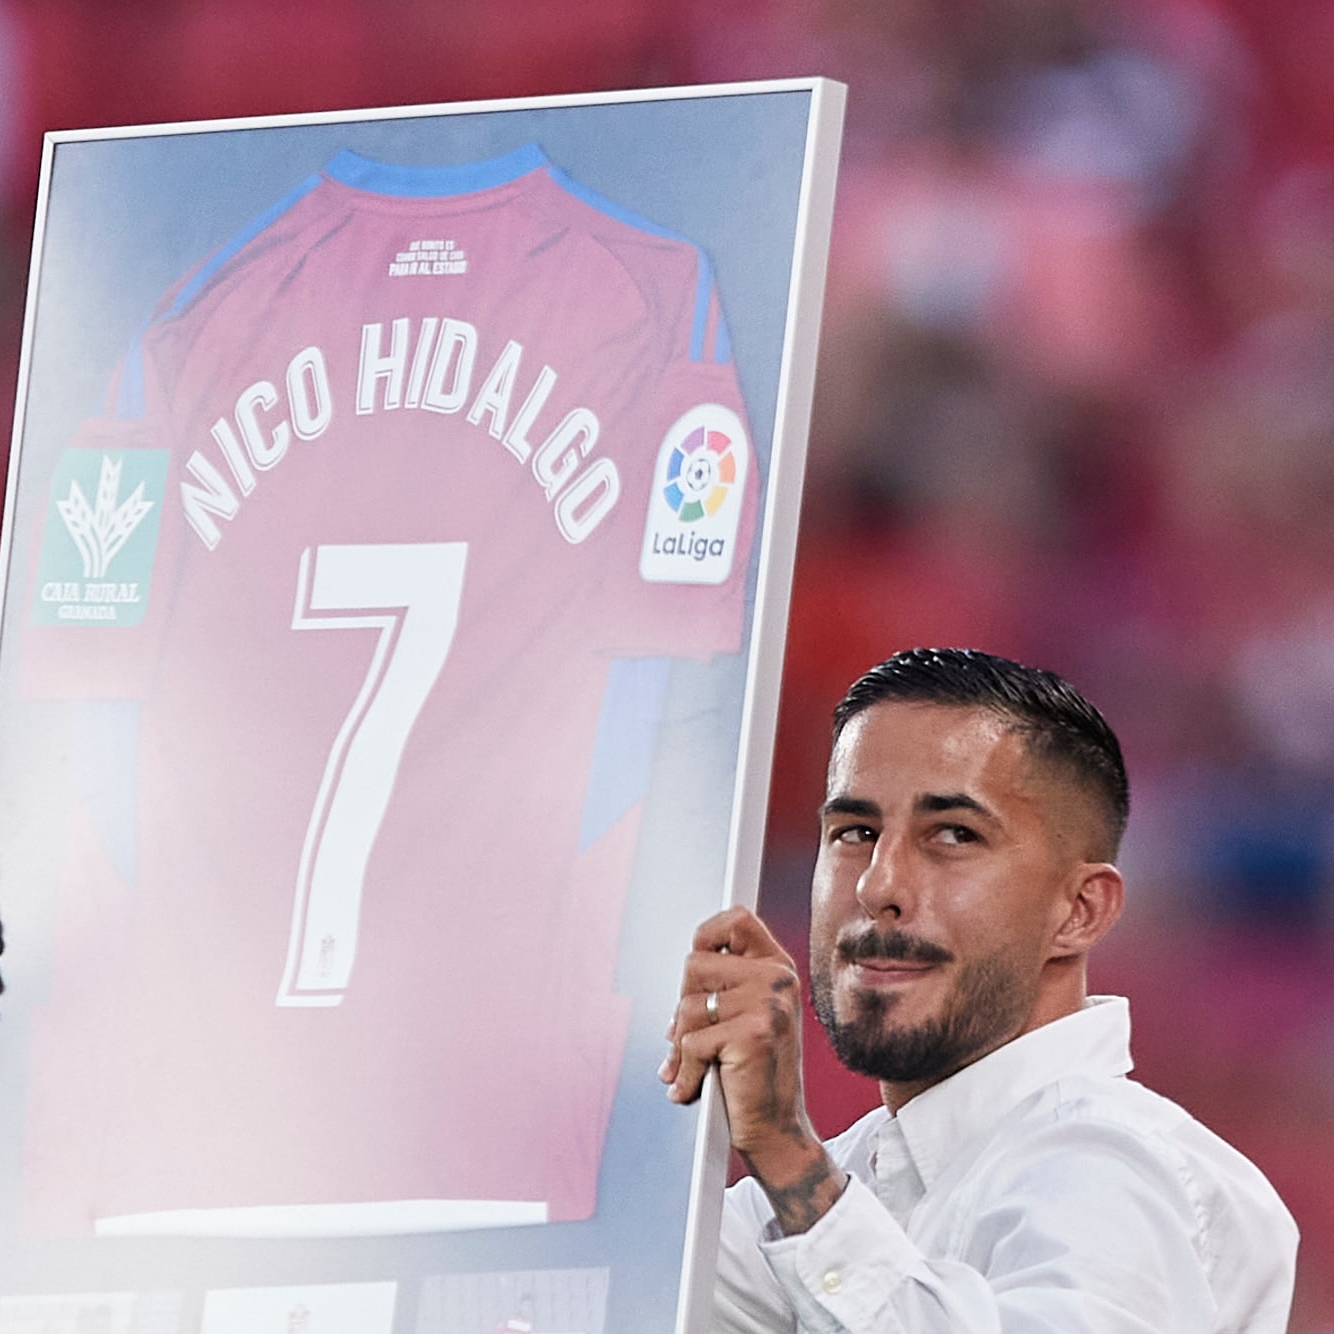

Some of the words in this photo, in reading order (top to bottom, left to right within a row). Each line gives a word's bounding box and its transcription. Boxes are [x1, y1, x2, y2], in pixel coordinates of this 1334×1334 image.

[180, 346, 332, 551] NICO
[355, 317, 620, 545] HIDALGO
[41, 582, 80, 602] CAJA
[83, 583, 140, 603] RURAL
[652, 531, 725, 561] LaLiga
[274, 541, 469, 1007] 7
